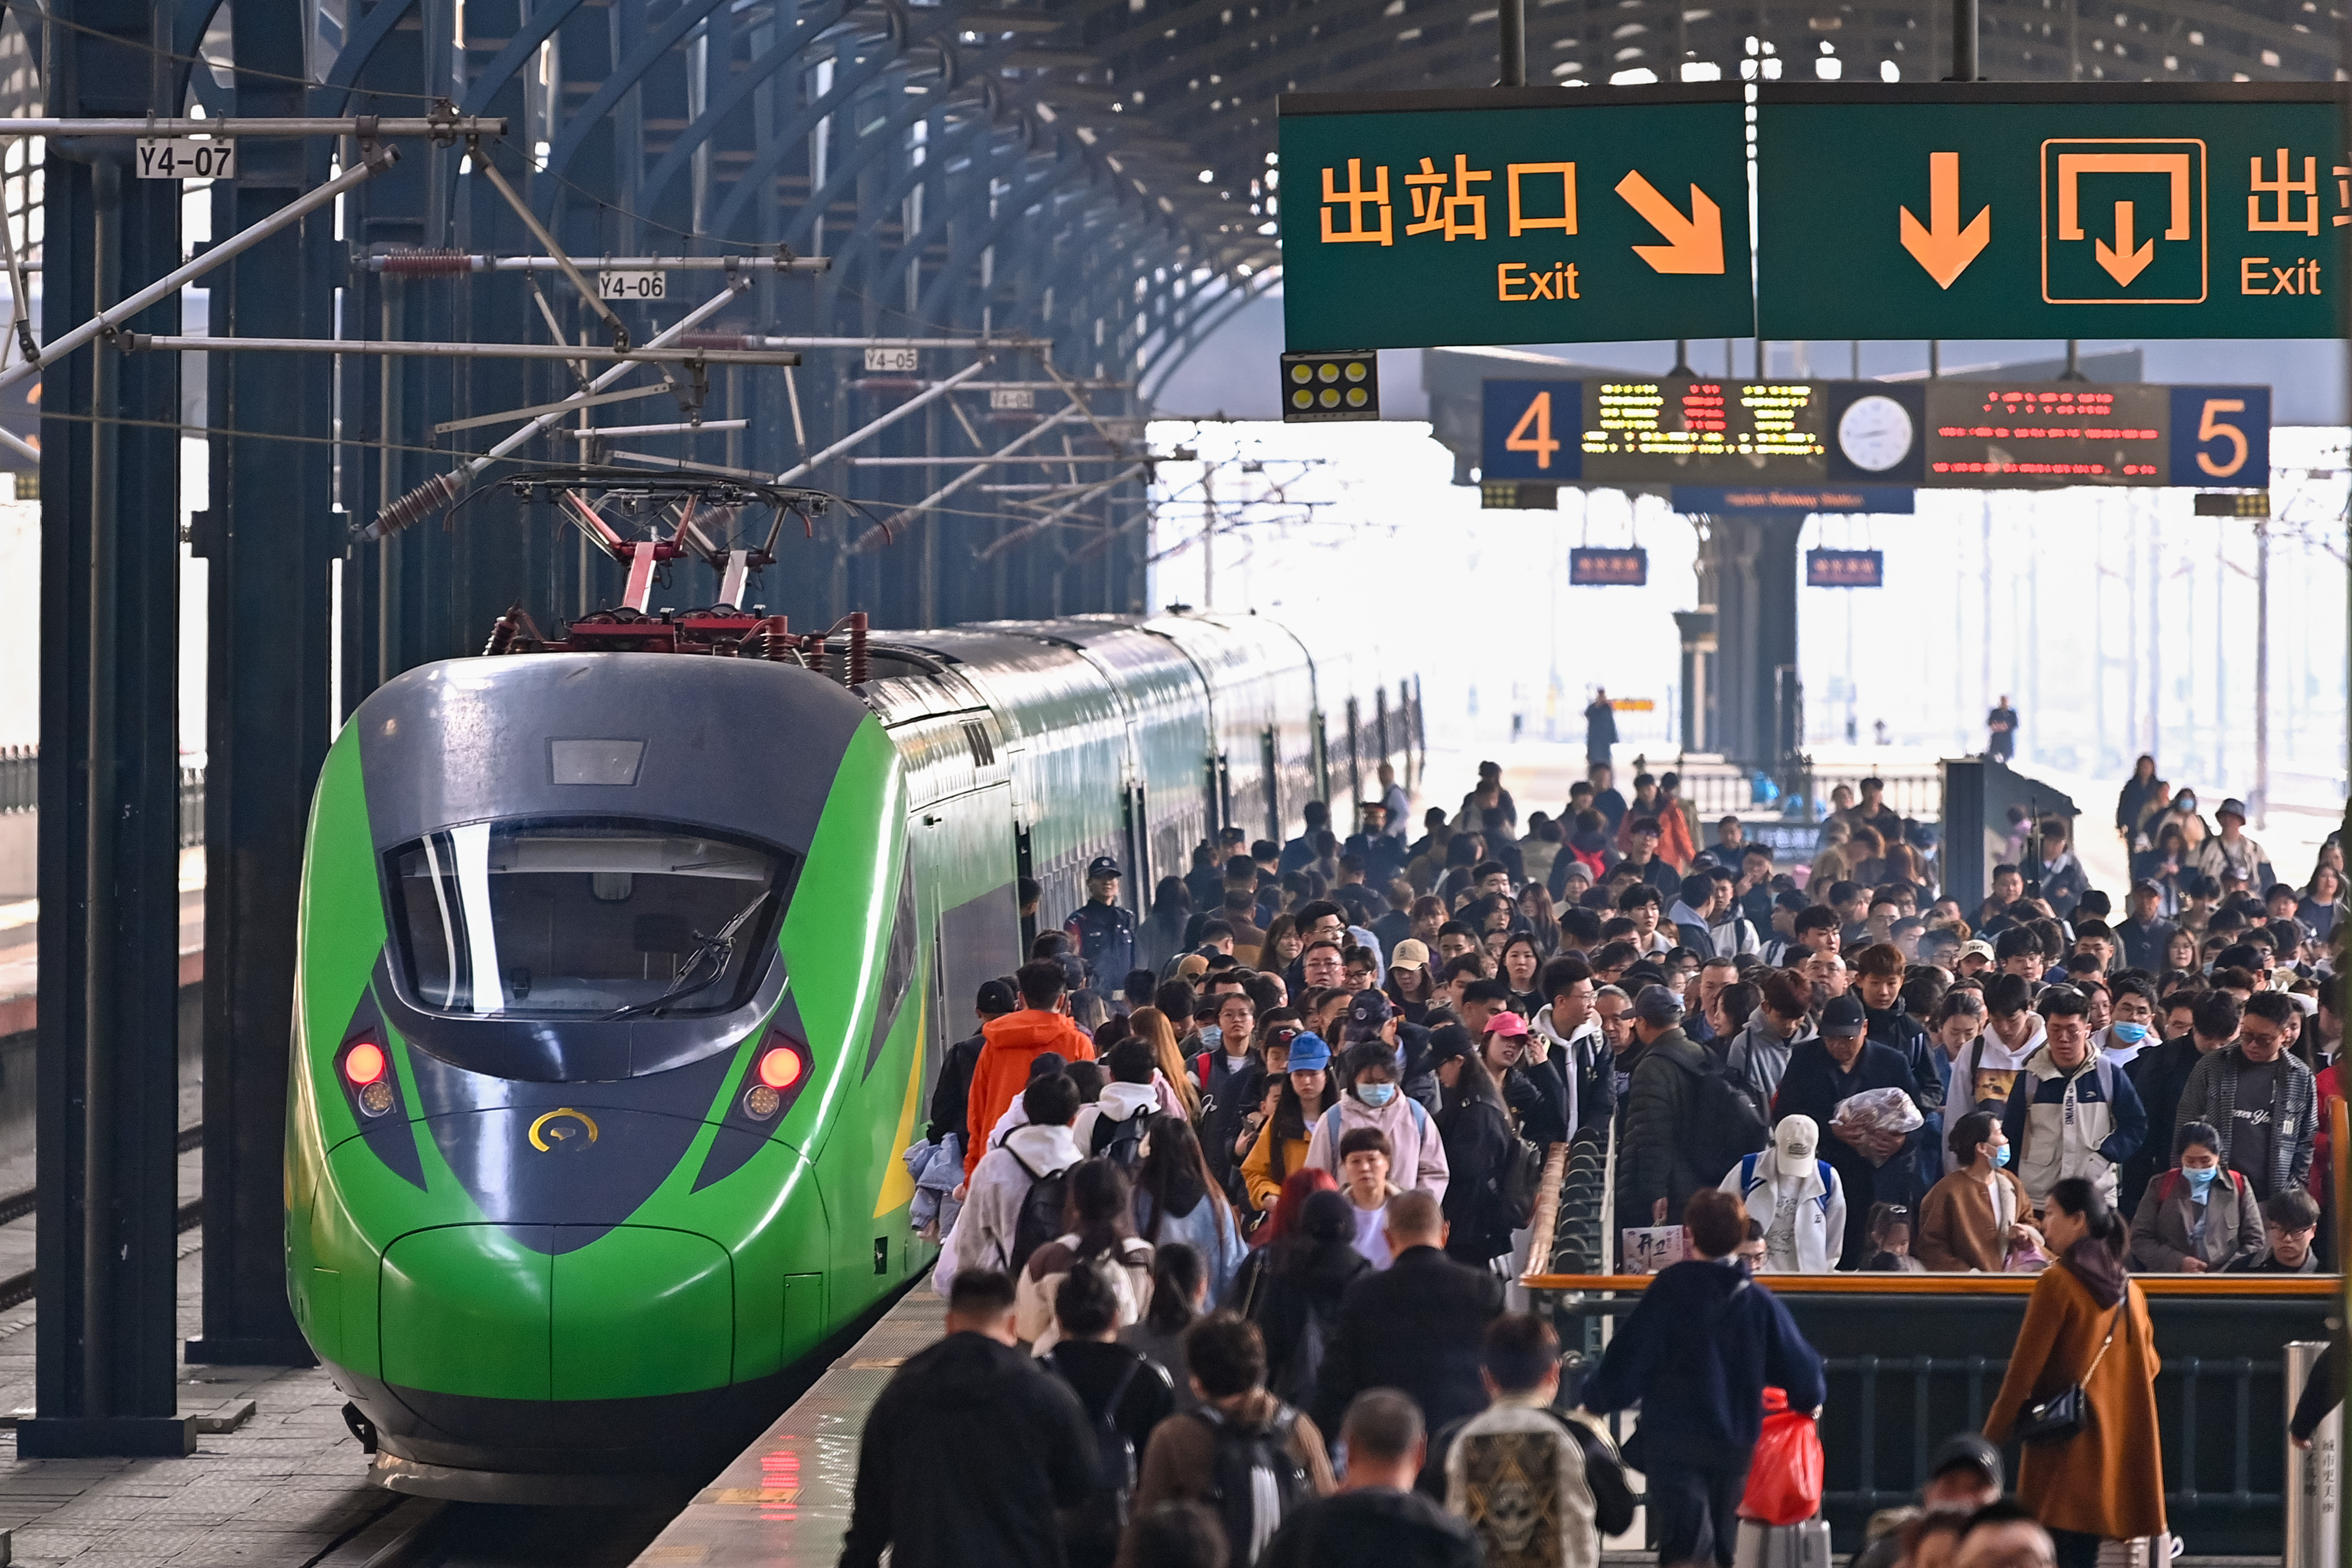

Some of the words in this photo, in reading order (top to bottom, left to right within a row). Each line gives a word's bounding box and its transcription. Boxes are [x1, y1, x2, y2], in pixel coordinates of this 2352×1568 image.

[140, 147, 232, 176] Y4-07
[1321, 154, 1577, 246] 出站口
[601, 278, 662, 296] Y4-06
[1499, 262, 1579, 301] Exit
[2242, 258, 2321, 294] Exit
[867, 353, 914, 368] Y4-05
[1507, 392, 1559, 468] 4
[2198, 400, 2247, 476] 5
